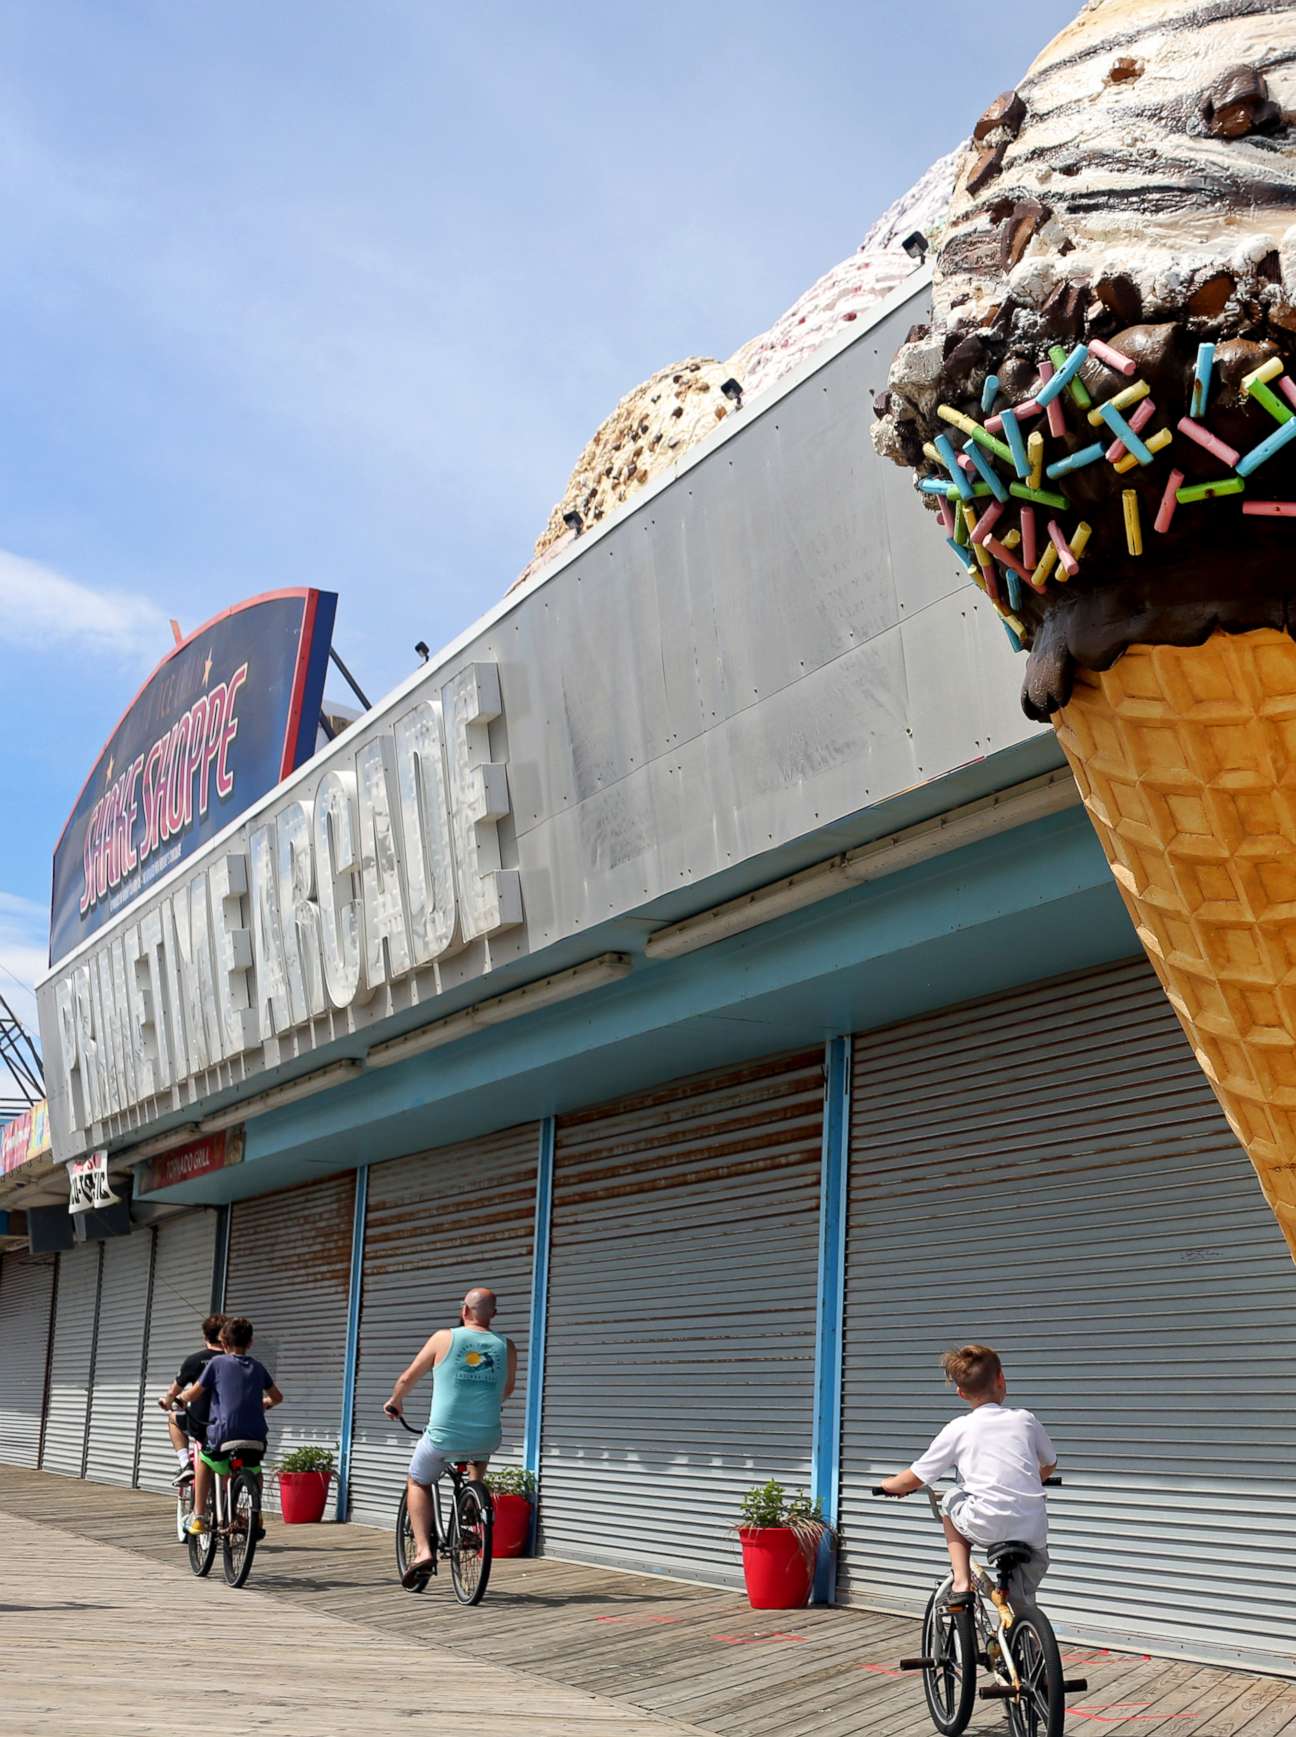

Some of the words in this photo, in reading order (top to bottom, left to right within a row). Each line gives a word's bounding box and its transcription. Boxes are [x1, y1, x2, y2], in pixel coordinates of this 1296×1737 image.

[81, 753, 144, 914] SHAKE
[141, 662, 248, 862] SHOPPE
[249, 662, 524, 1043] ARCADE
